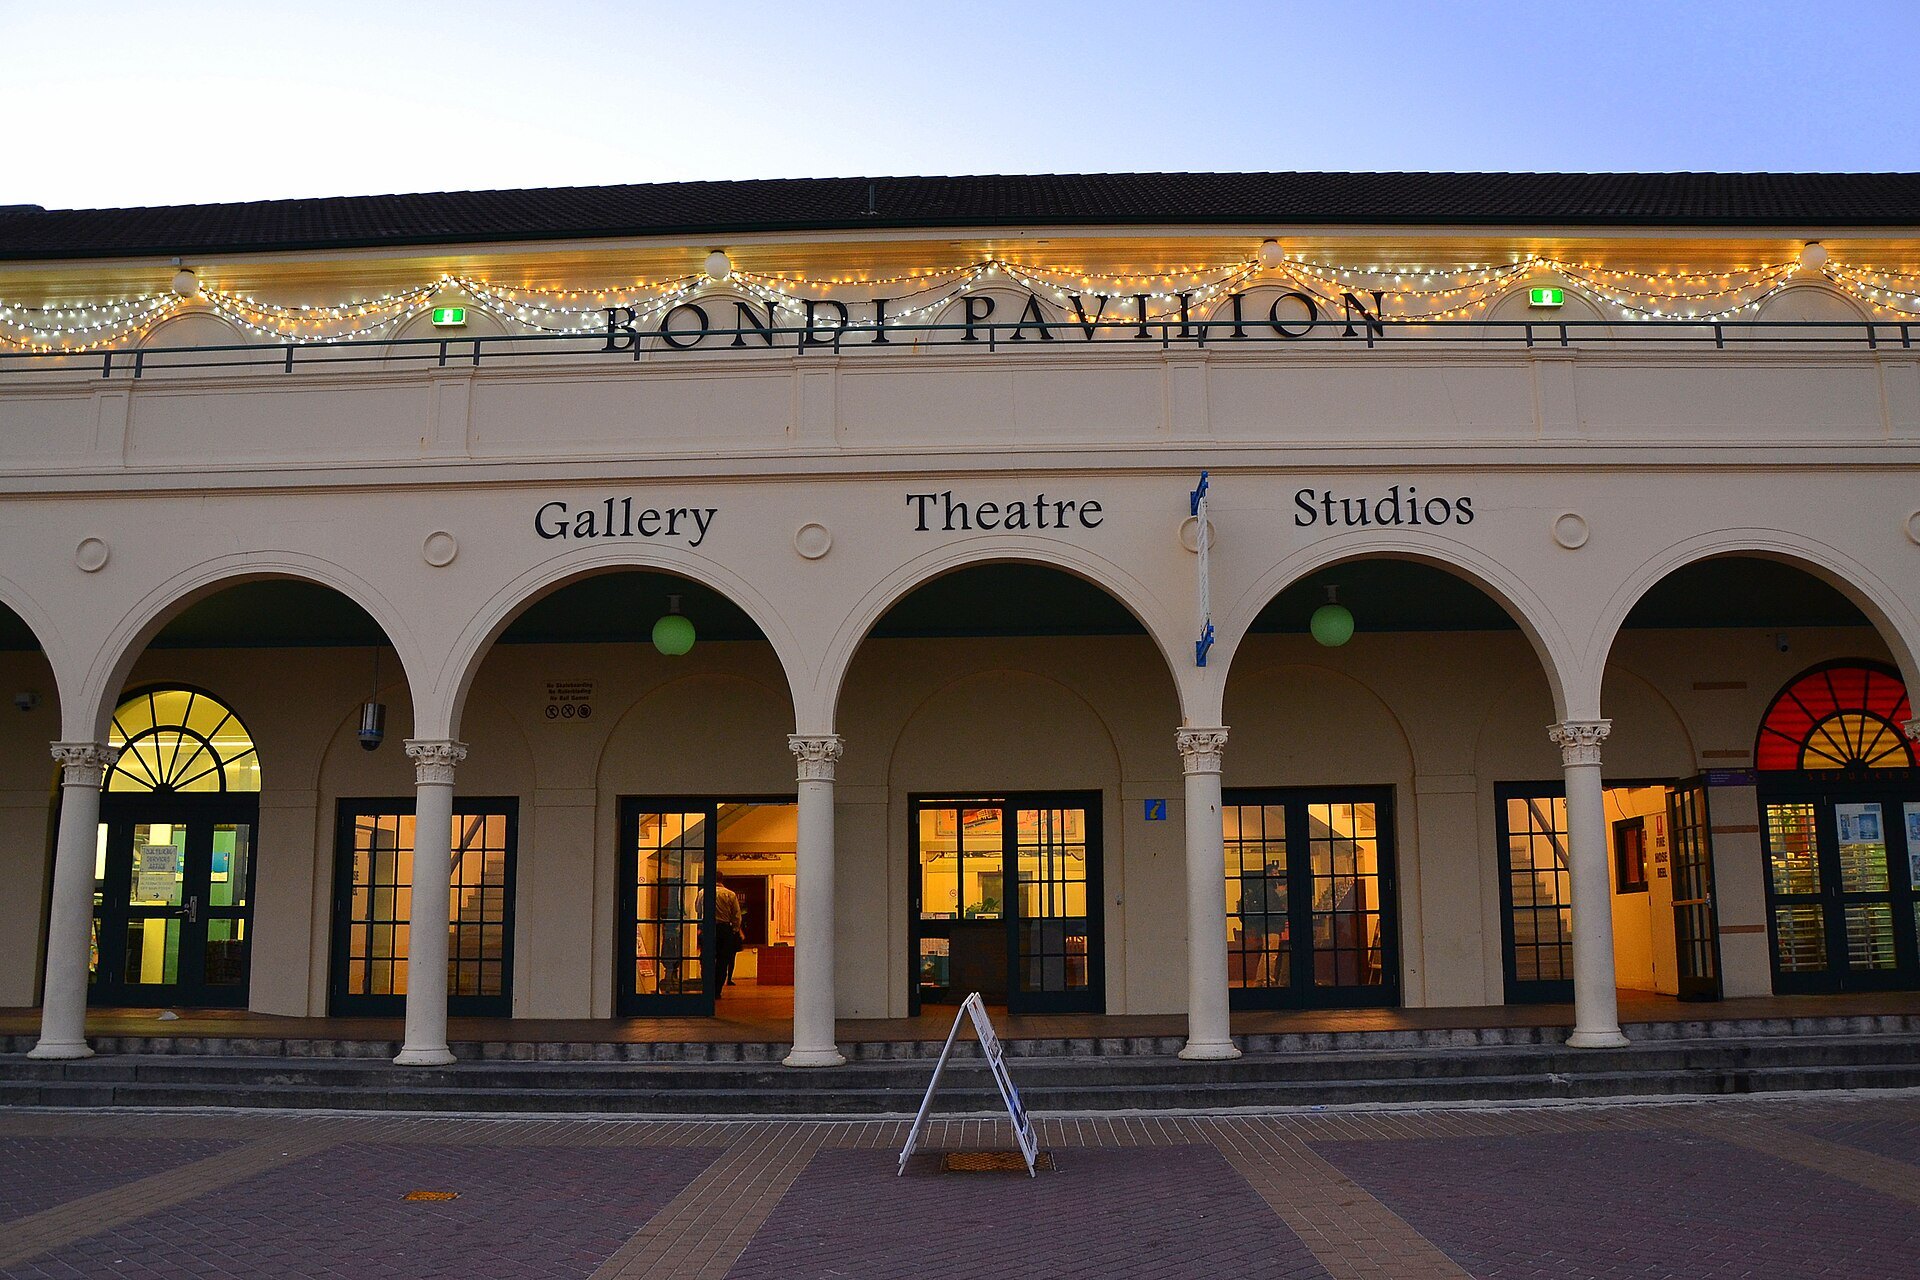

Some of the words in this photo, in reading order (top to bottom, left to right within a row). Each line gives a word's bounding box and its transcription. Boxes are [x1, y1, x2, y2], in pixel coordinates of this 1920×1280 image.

[601, 298, 891, 351] BONDI
[960, 291, 1385, 341] PAVILION
[534, 496, 719, 548] Gallery
[905, 490, 1105, 532] Theatre
[1294, 484, 1475, 527] Studios
[1655, 851, 1668, 863] HOSE
[1656, 836, 1666, 848] FIRE
[1657, 867, 1668, 879] REEL
